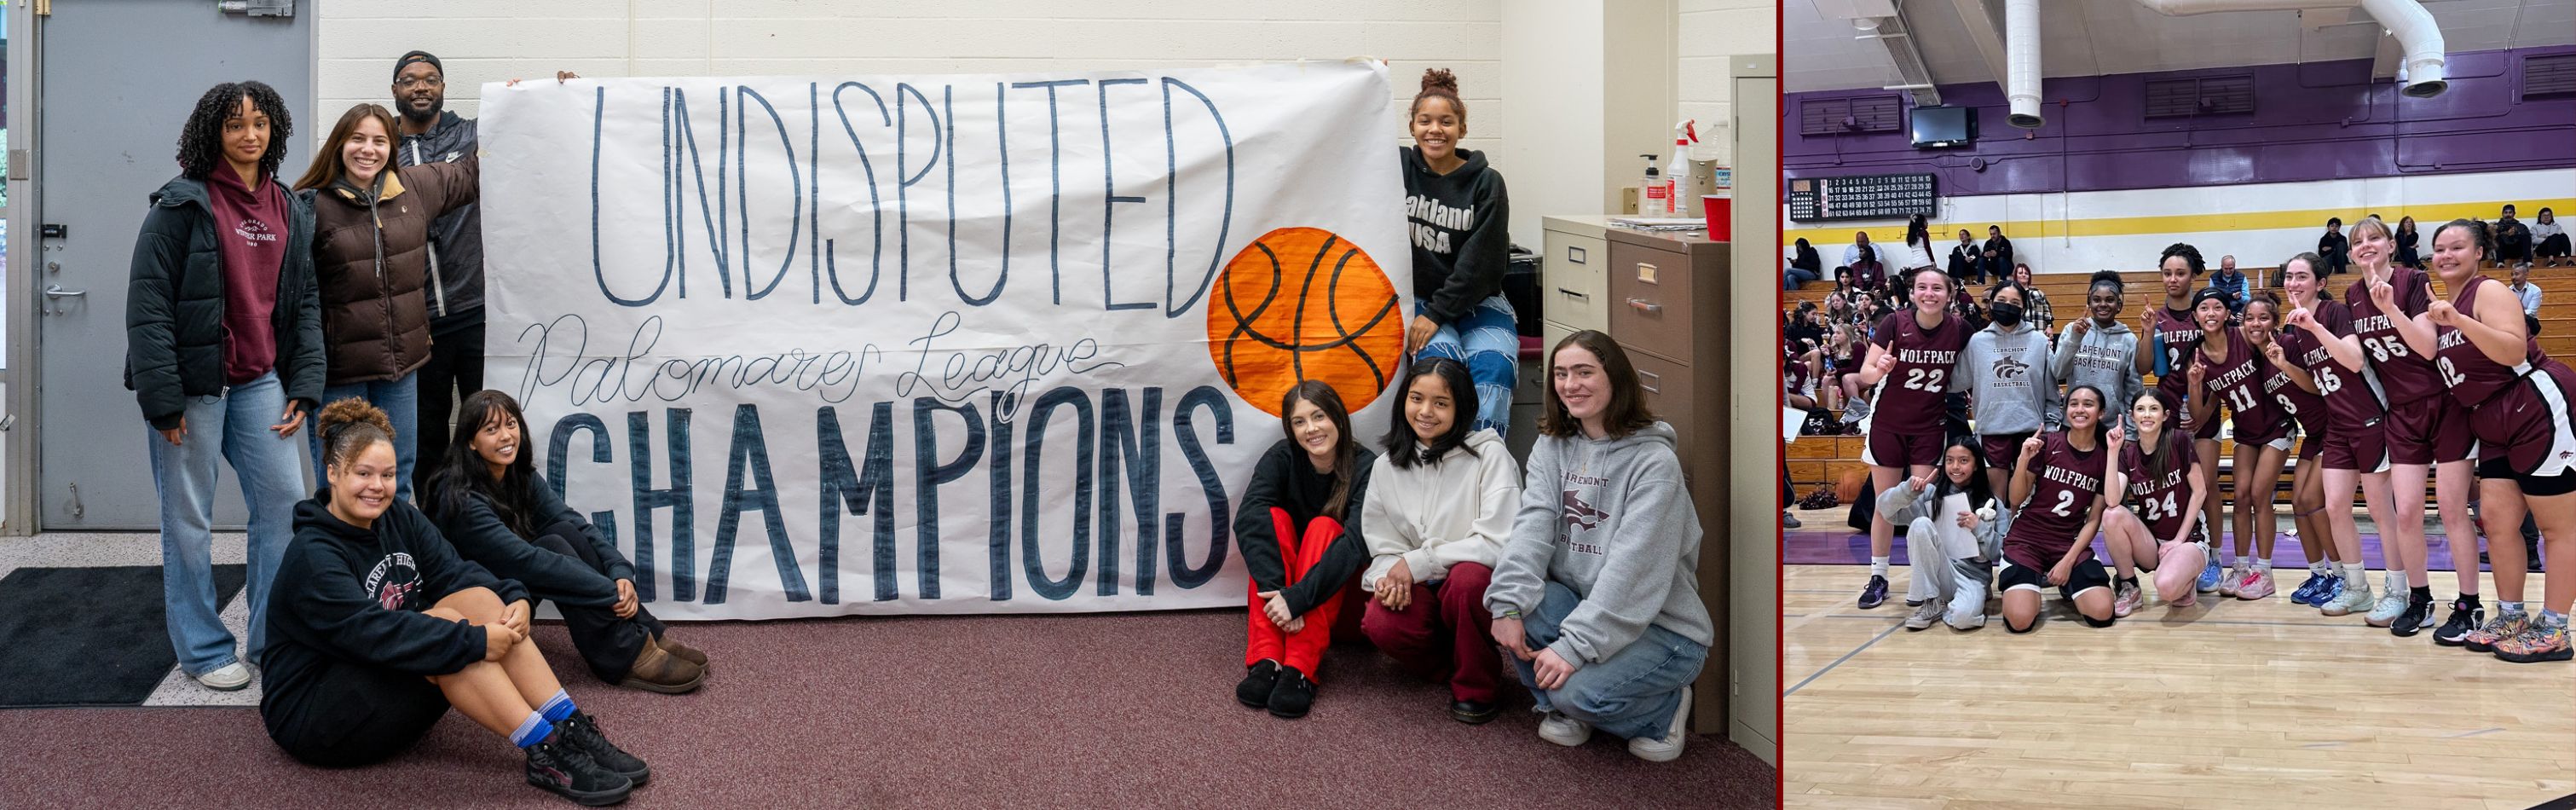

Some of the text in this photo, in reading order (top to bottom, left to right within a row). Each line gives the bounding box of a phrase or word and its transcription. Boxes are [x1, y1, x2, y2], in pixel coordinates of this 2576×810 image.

[592, 77, 1233, 318] UNDISPUTED
[1406, 194, 1475, 231] akland
[257, 233, 277, 241] PARK
[1899, 348, 1956, 364] WOLFPACK
[2078, 345, 2122, 358] LAREMONT
[2364, 335, 2408, 362] 35
[517, 310, 1125, 423] Palomares League
[2074, 356, 2119, 372] BASKETBALL
[1904, 368, 1944, 393] 22
[2229, 384, 2257, 413] 11
[2277, 393, 2297, 414] 3
[2043, 465, 2099, 492] WOLFPACK
[2129, 468, 2181, 495] WOLFACK
[546, 385, 1234, 605] CHAMPIONS
[2051, 489, 2075, 518] 2
[2145, 490, 2178, 520] 24
